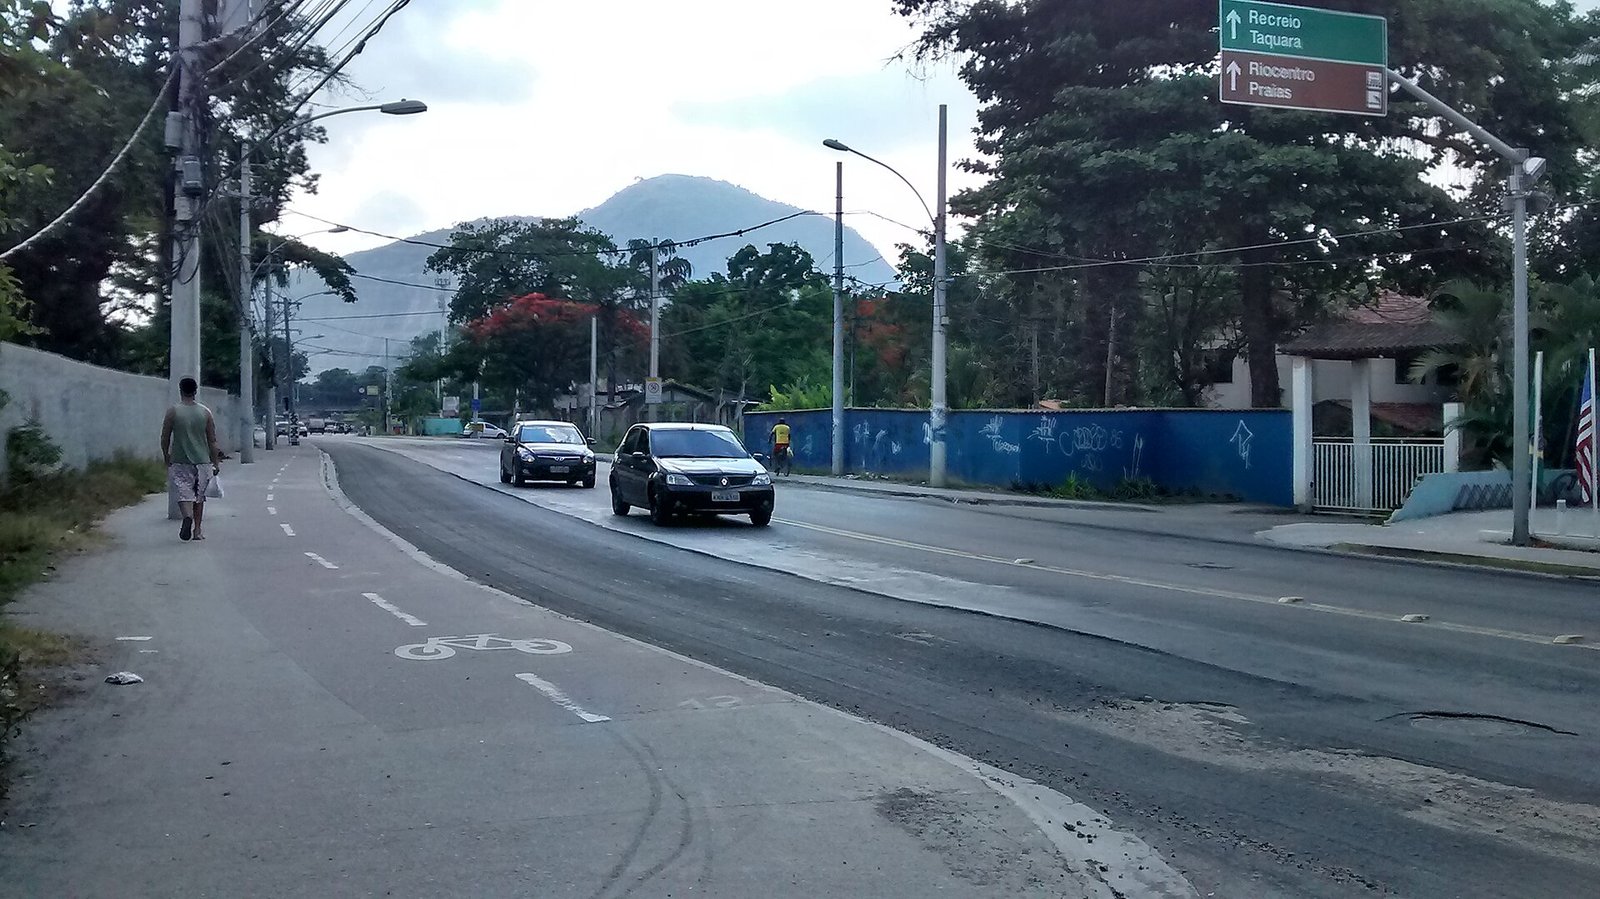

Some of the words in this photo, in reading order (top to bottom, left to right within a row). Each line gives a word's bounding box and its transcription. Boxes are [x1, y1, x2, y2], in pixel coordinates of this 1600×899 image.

[1249, 10, 1301, 29] Recreio
[1250, 30, 1302, 49] Taquara
[1249, 61, 1316, 82] Riocentro
[1249, 82, 1292, 99] Praias
